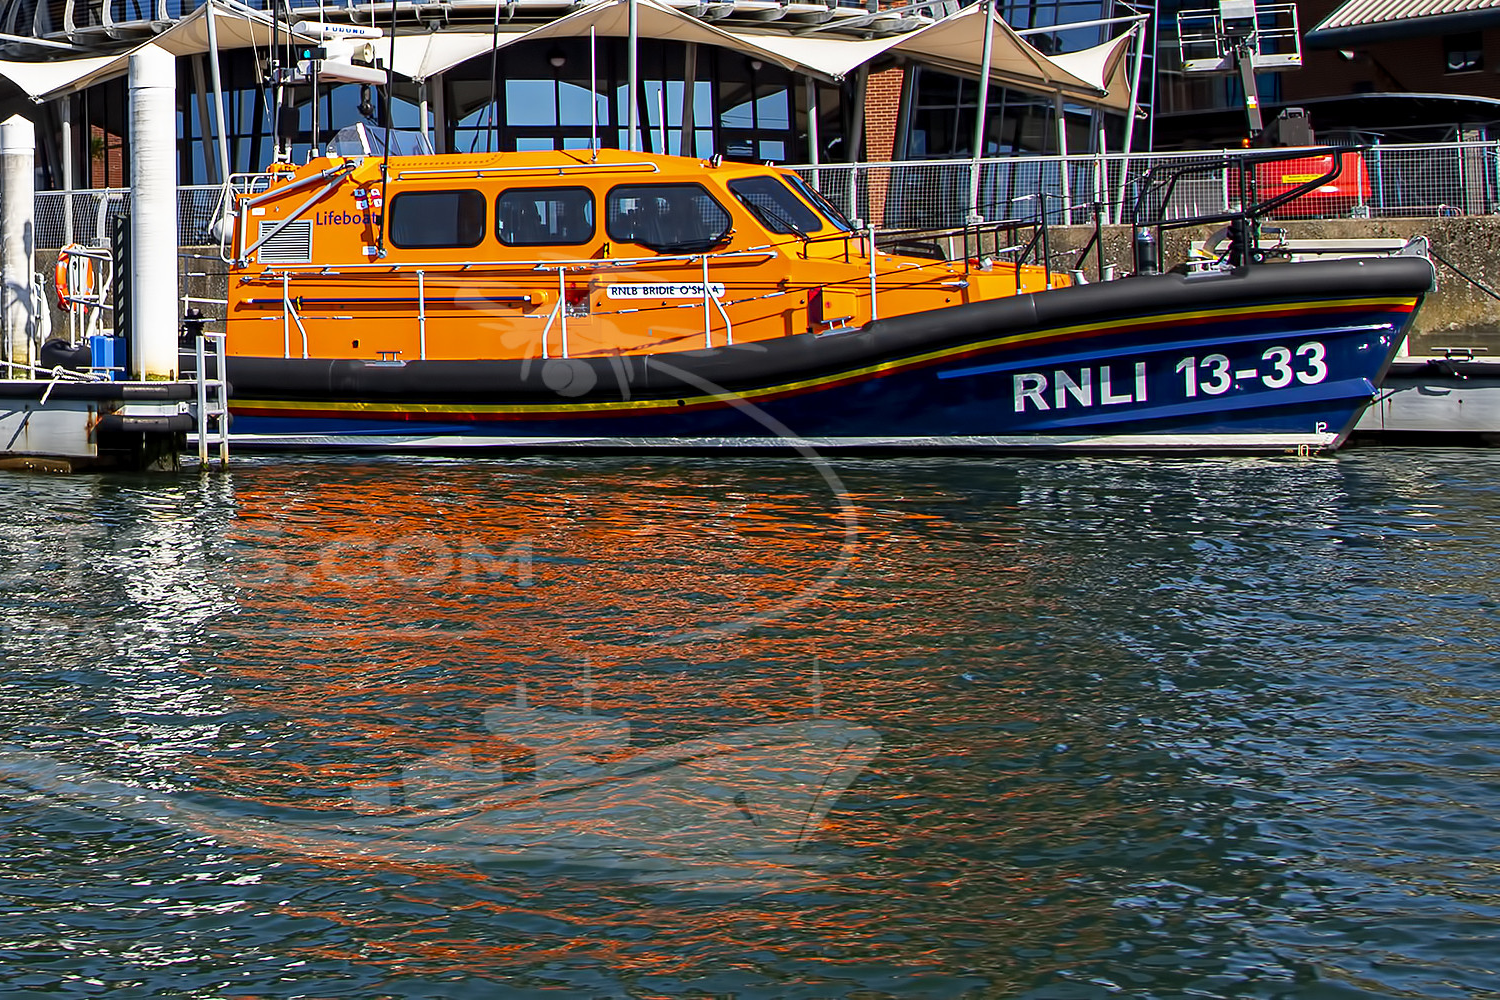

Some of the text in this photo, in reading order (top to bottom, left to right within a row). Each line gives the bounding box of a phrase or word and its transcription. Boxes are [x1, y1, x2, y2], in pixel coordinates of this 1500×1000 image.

[611, 286, 638, 296] RNLB
[642, 285, 675, 295] BRIDIE
[1012, 341, 1329, 413] RNLI 13-33
